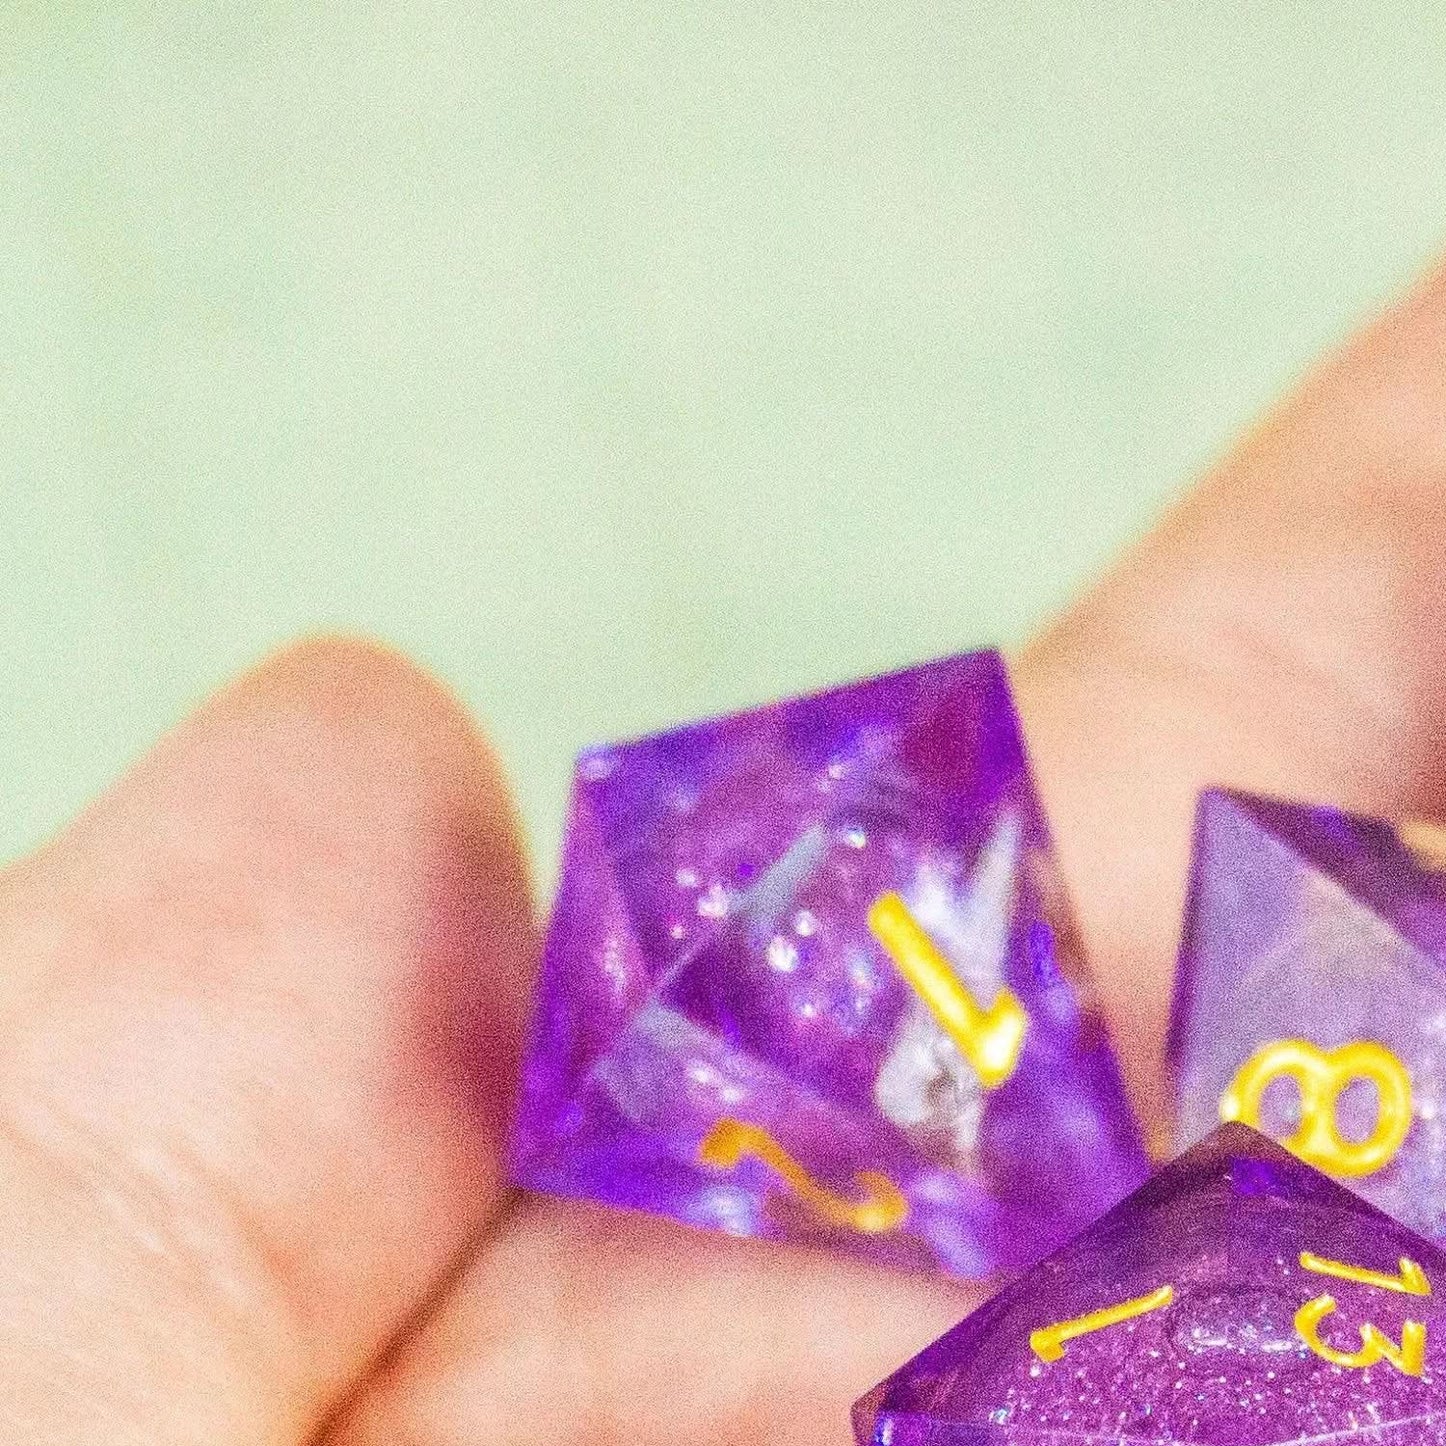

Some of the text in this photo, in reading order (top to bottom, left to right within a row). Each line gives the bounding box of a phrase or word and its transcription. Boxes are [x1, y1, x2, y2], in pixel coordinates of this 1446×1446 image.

[867, 890, 1028, 1088] 1
[1221, 1039, 1414, 1178] 8
[1028, 1285, 1176, 1363] 1
[1293, 1250, 1432, 1377] 13
